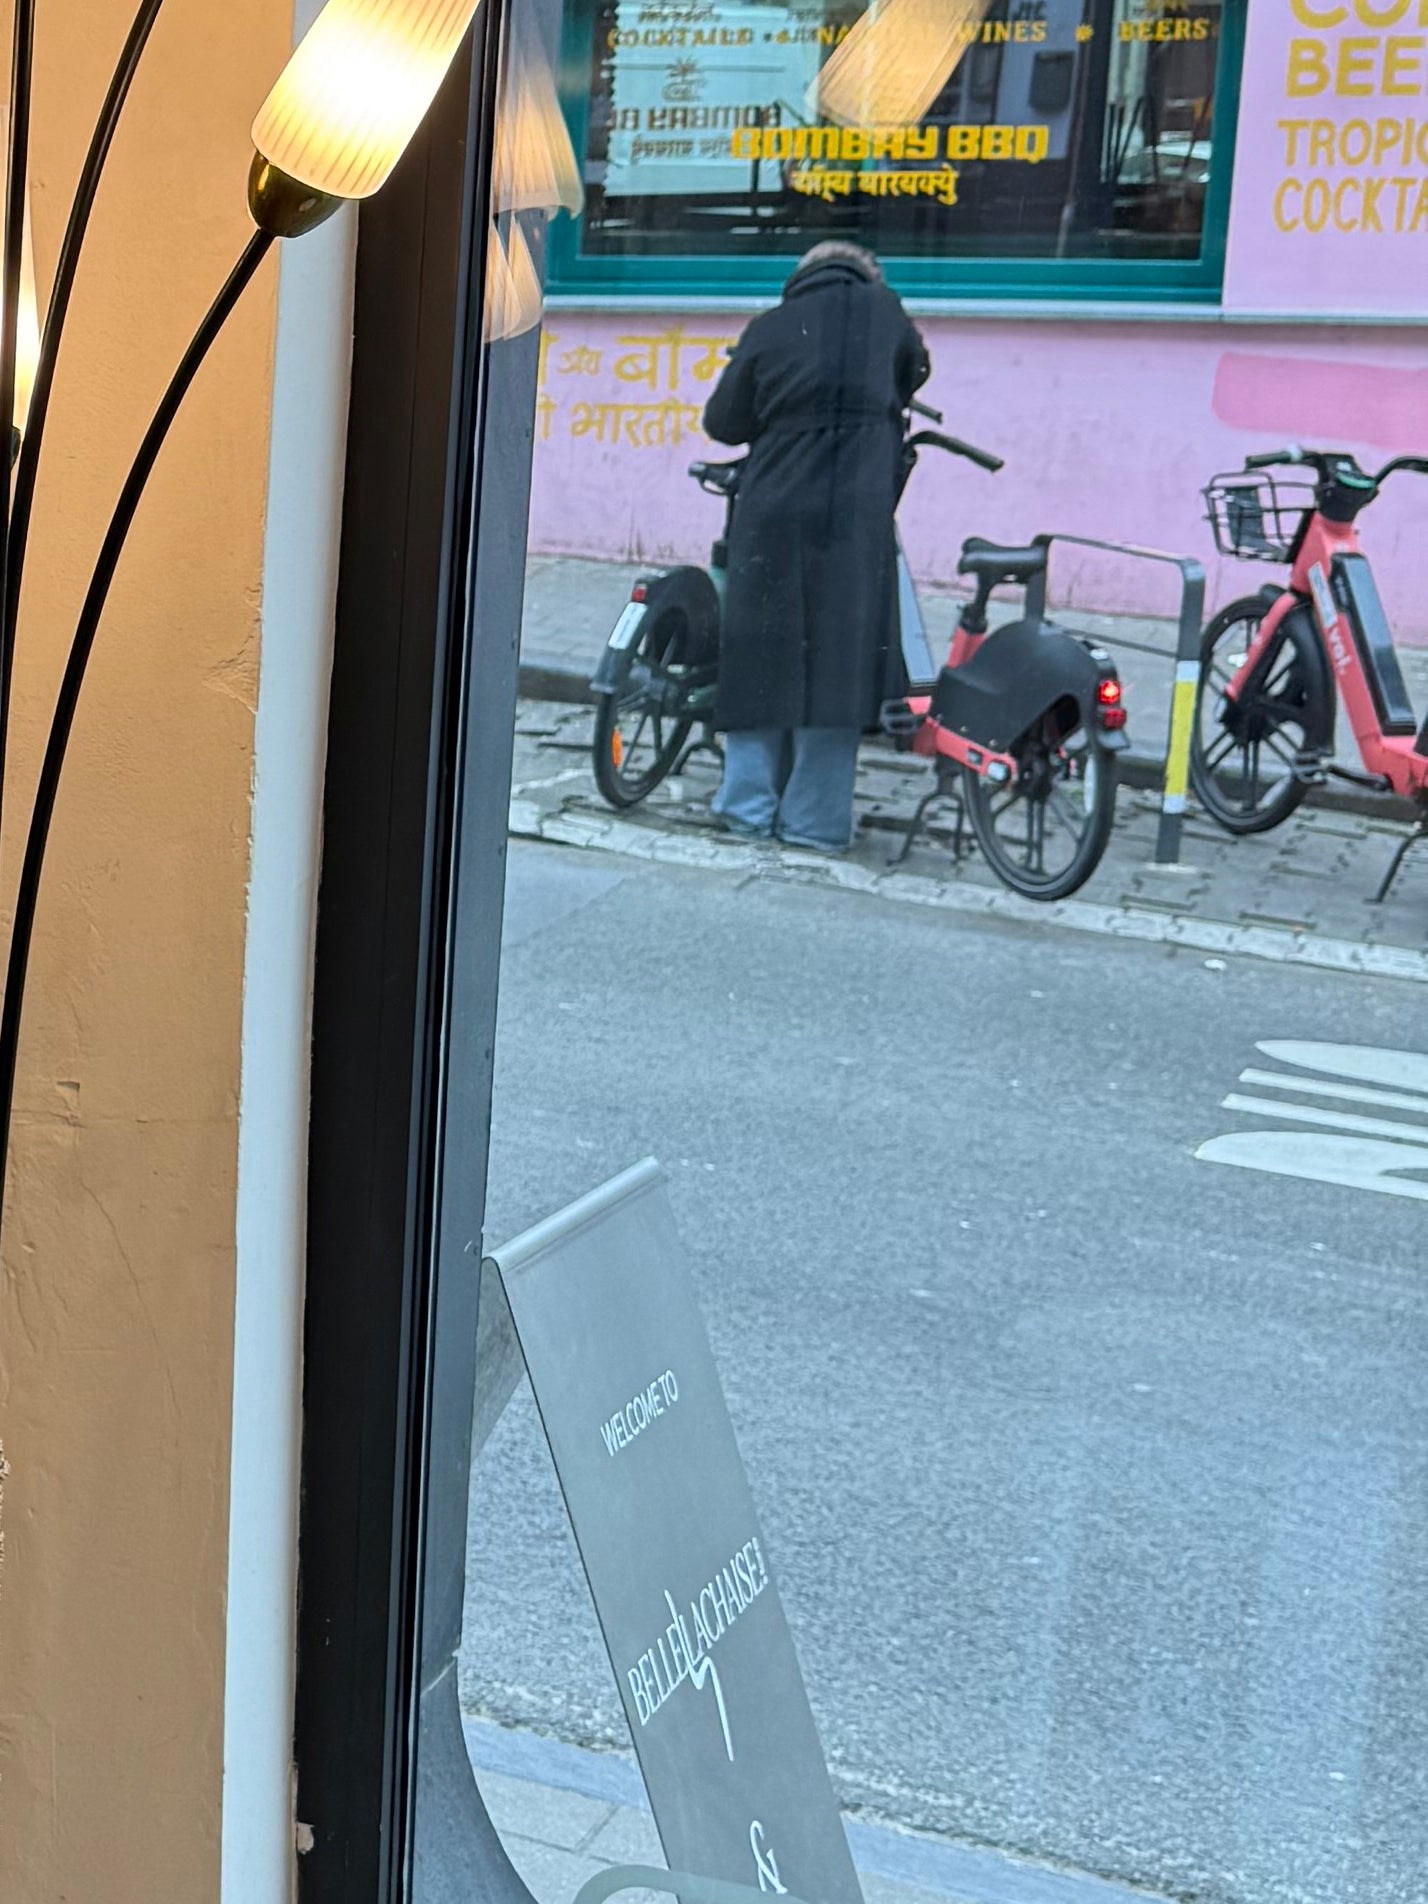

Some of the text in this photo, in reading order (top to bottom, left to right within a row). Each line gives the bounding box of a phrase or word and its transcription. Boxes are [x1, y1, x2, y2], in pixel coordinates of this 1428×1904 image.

[1119, 17, 1210, 42] BEERS
[1285, 34, 1428, 98] BEE
[730, 124, 940, 161] BOMBAY
[945, 123, 1050, 164] BBQ
[599, 1368, 679, 1457] WELCOME TO
[749, 1819, 789, 1895] &
